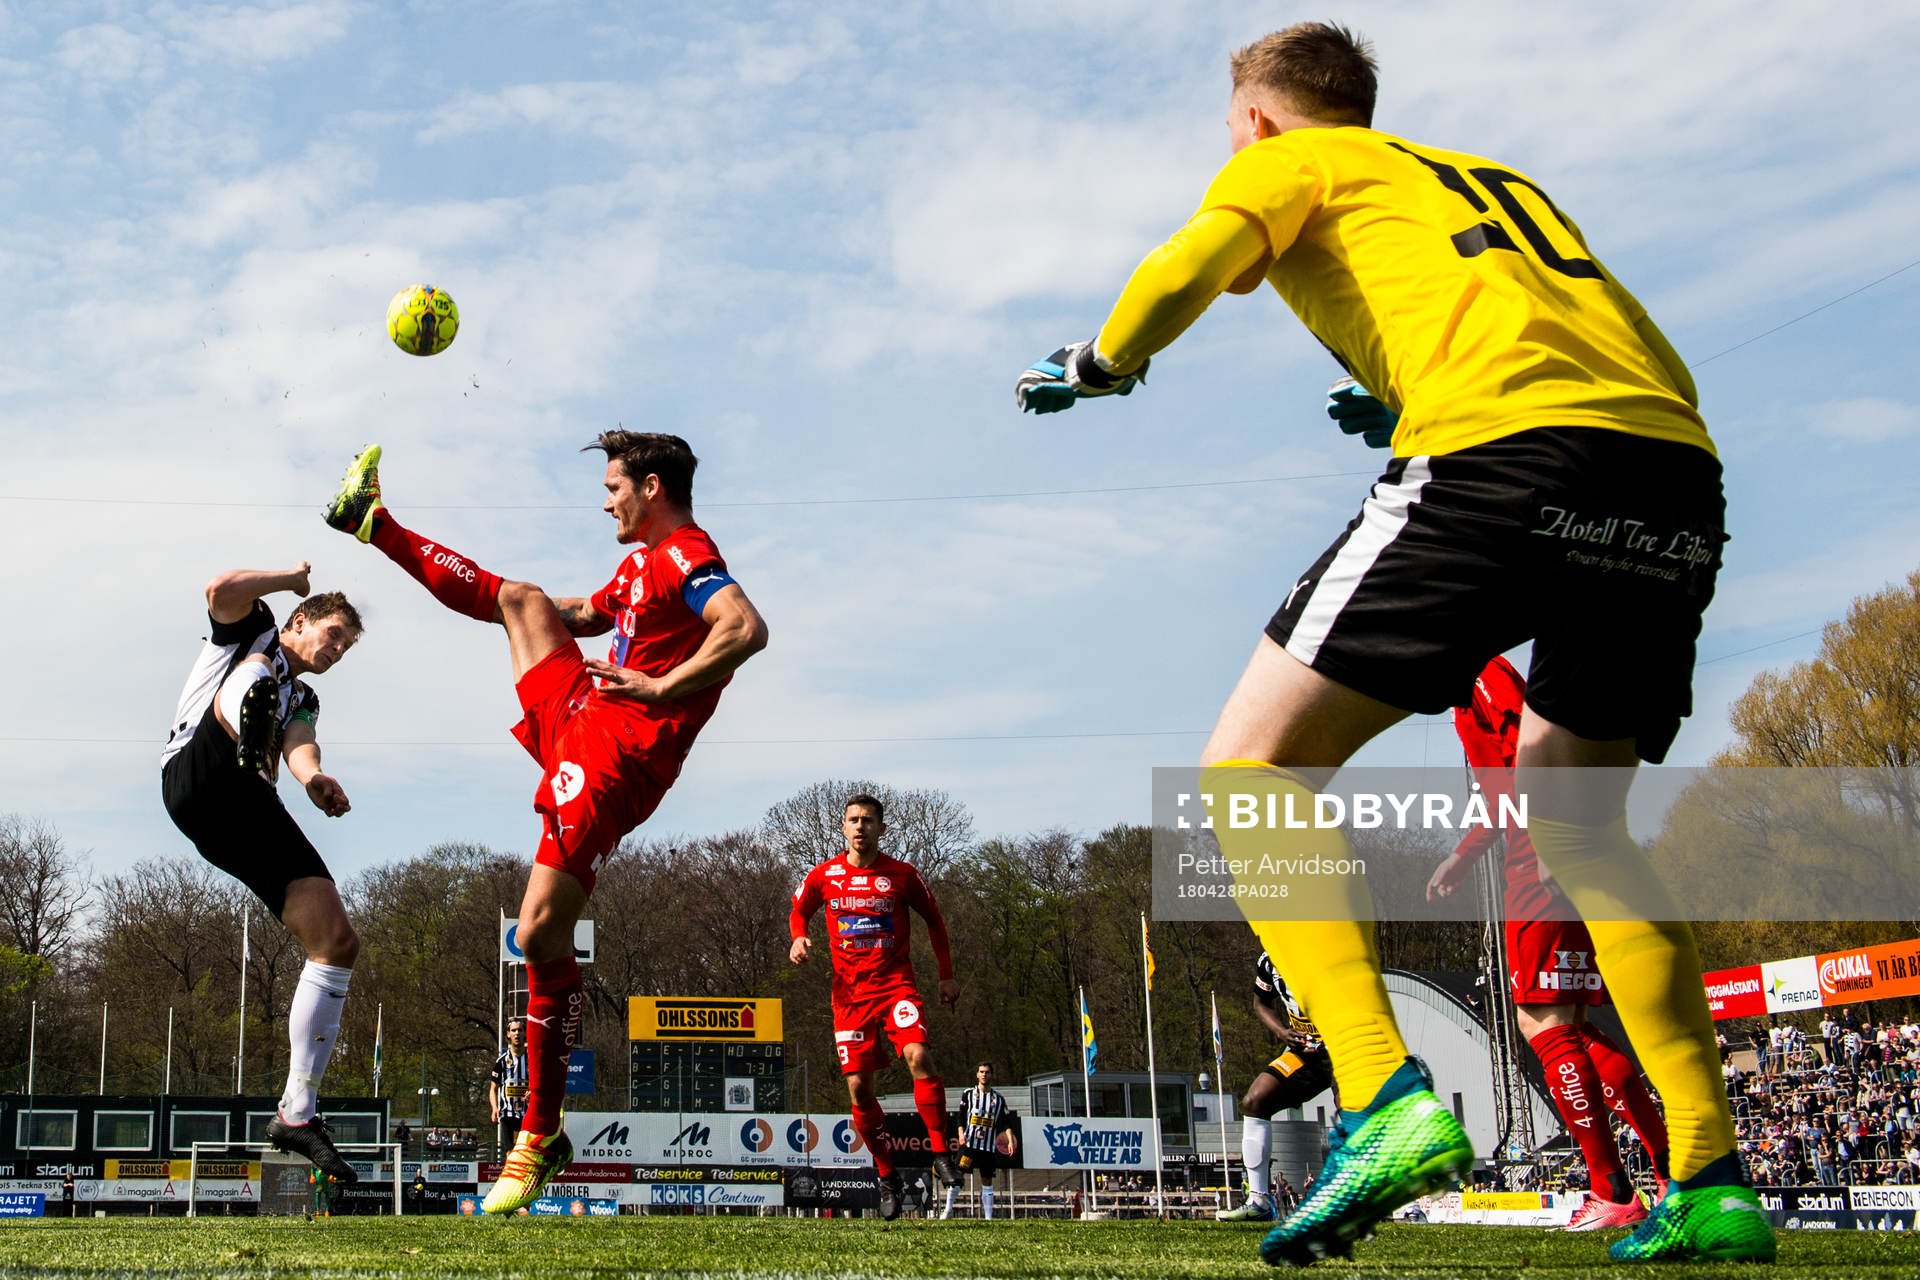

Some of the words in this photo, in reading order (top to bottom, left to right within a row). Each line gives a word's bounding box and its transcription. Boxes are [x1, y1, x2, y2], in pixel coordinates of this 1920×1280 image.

[1531, 506, 1619, 546] Hotell
[1623, 519, 1659, 552] Tre
[420, 543, 435, 557] 4
[433, 552, 476, 583] office
[851, 876, 868, 885] 3M
[1832, 953, 1872, 981] LOKAL
[1876, 959, 1890, 981] VI
[1890, 954, 1907, 980] ÄR
[1835, 977, 1873, 992] TIDNINGEN
[1782, 990, 1819, 1004] PRENAD
[561, 992, 583, 1047] office
[657, 1009, 740, 1028] OHLSSONS
[632, 1045, 639, 1055] A
[663, 1045, 670, 1055] E
[663, 1062, 670, 1072] F
[1558, 1062, 1589, 1111] office
[663, 1097, 670, 1107] H
[1613, 1100, 1625, 1111] 4
[1574, 1116, 1594, 1128] 4
[582, 1149, 633, 1157] MIDROC
[663, 1149, 713, 1158] MIDROC
[1081, 1148, 1116, 1164] TELE
[1119, 1148, 1142, 1164] AB
[36, 1163, 95, 1176] stadium
[119, 1165, 162, 1175] OHLSSONS
[197, 1165, 240, 1175] OHLSSONS
[440, 1164, 468, 1172] Gården
[635, 1168, 704, 1180] Tedservice
[711, 1169, 779, 1181] Tedservice
[127, 1186, 162, 1198] magasin
[163, 1181, 176, 1196] A
[205, 1186, 239, 1198] magasin
[240, 1181, 253, 1196] A
[552, 1184, 589, 1198] MÖBLER
[821, 1180, 876, 1189] LANDSKRONA
[652, 1186, 704, 1204] KÖKS
[708, 1186, 765, 1204] Centrum
[821, 1190, 841, 1198] STAD
[1861, 1191, 1914, 1207] ENERCON
[1797, 1193, 1845, 1211] stadium
